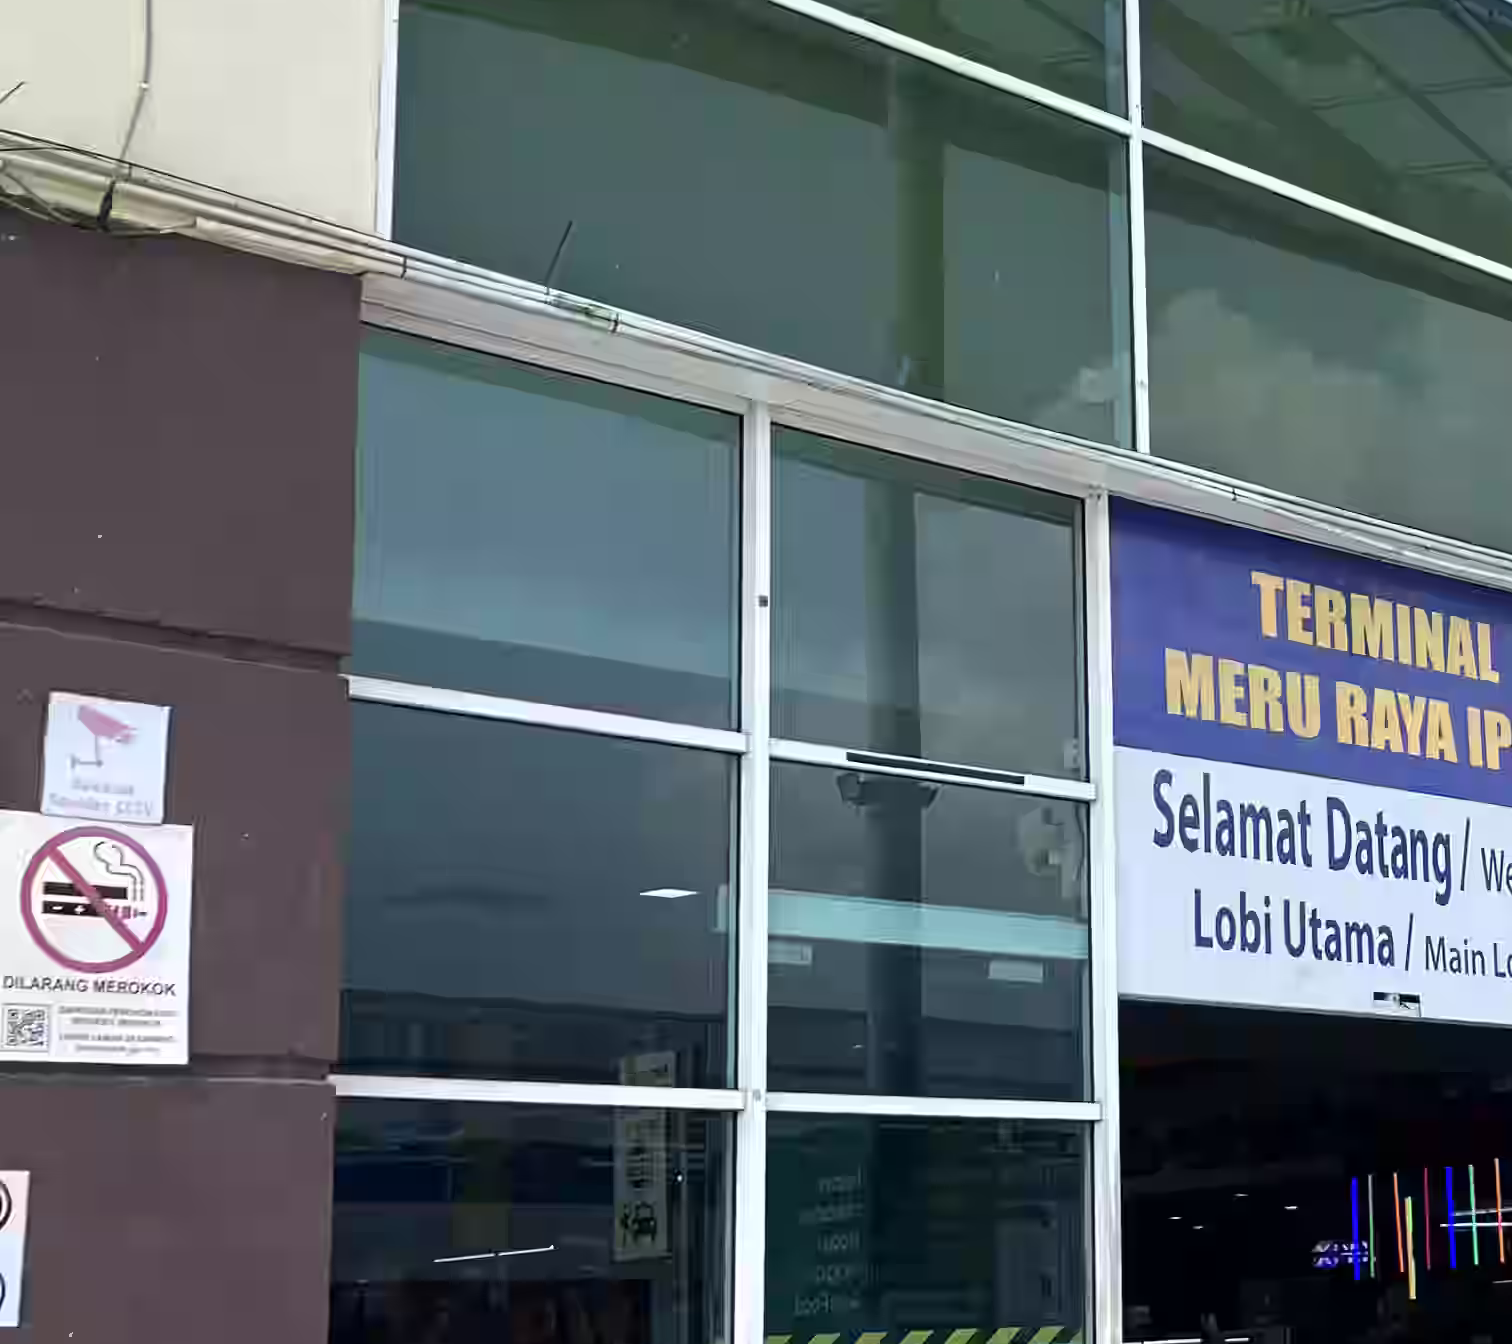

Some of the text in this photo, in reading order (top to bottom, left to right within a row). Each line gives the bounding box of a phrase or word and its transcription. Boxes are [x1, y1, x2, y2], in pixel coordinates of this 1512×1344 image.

[1251, 572, 1500, 683] TERMINAL
[1165, 648, 1321, 739] MERU
[1336, 681, 1457, 764] RAYA
[1153, 769, 1312, 868] Selamat
[1194, 888, 1272, 955] Lobi
[1283, 900, 1395, 967] Utama
[1425, 935, 1486, 977] Main
[2, 975, 177, 997] DILARANG MEROKOK
